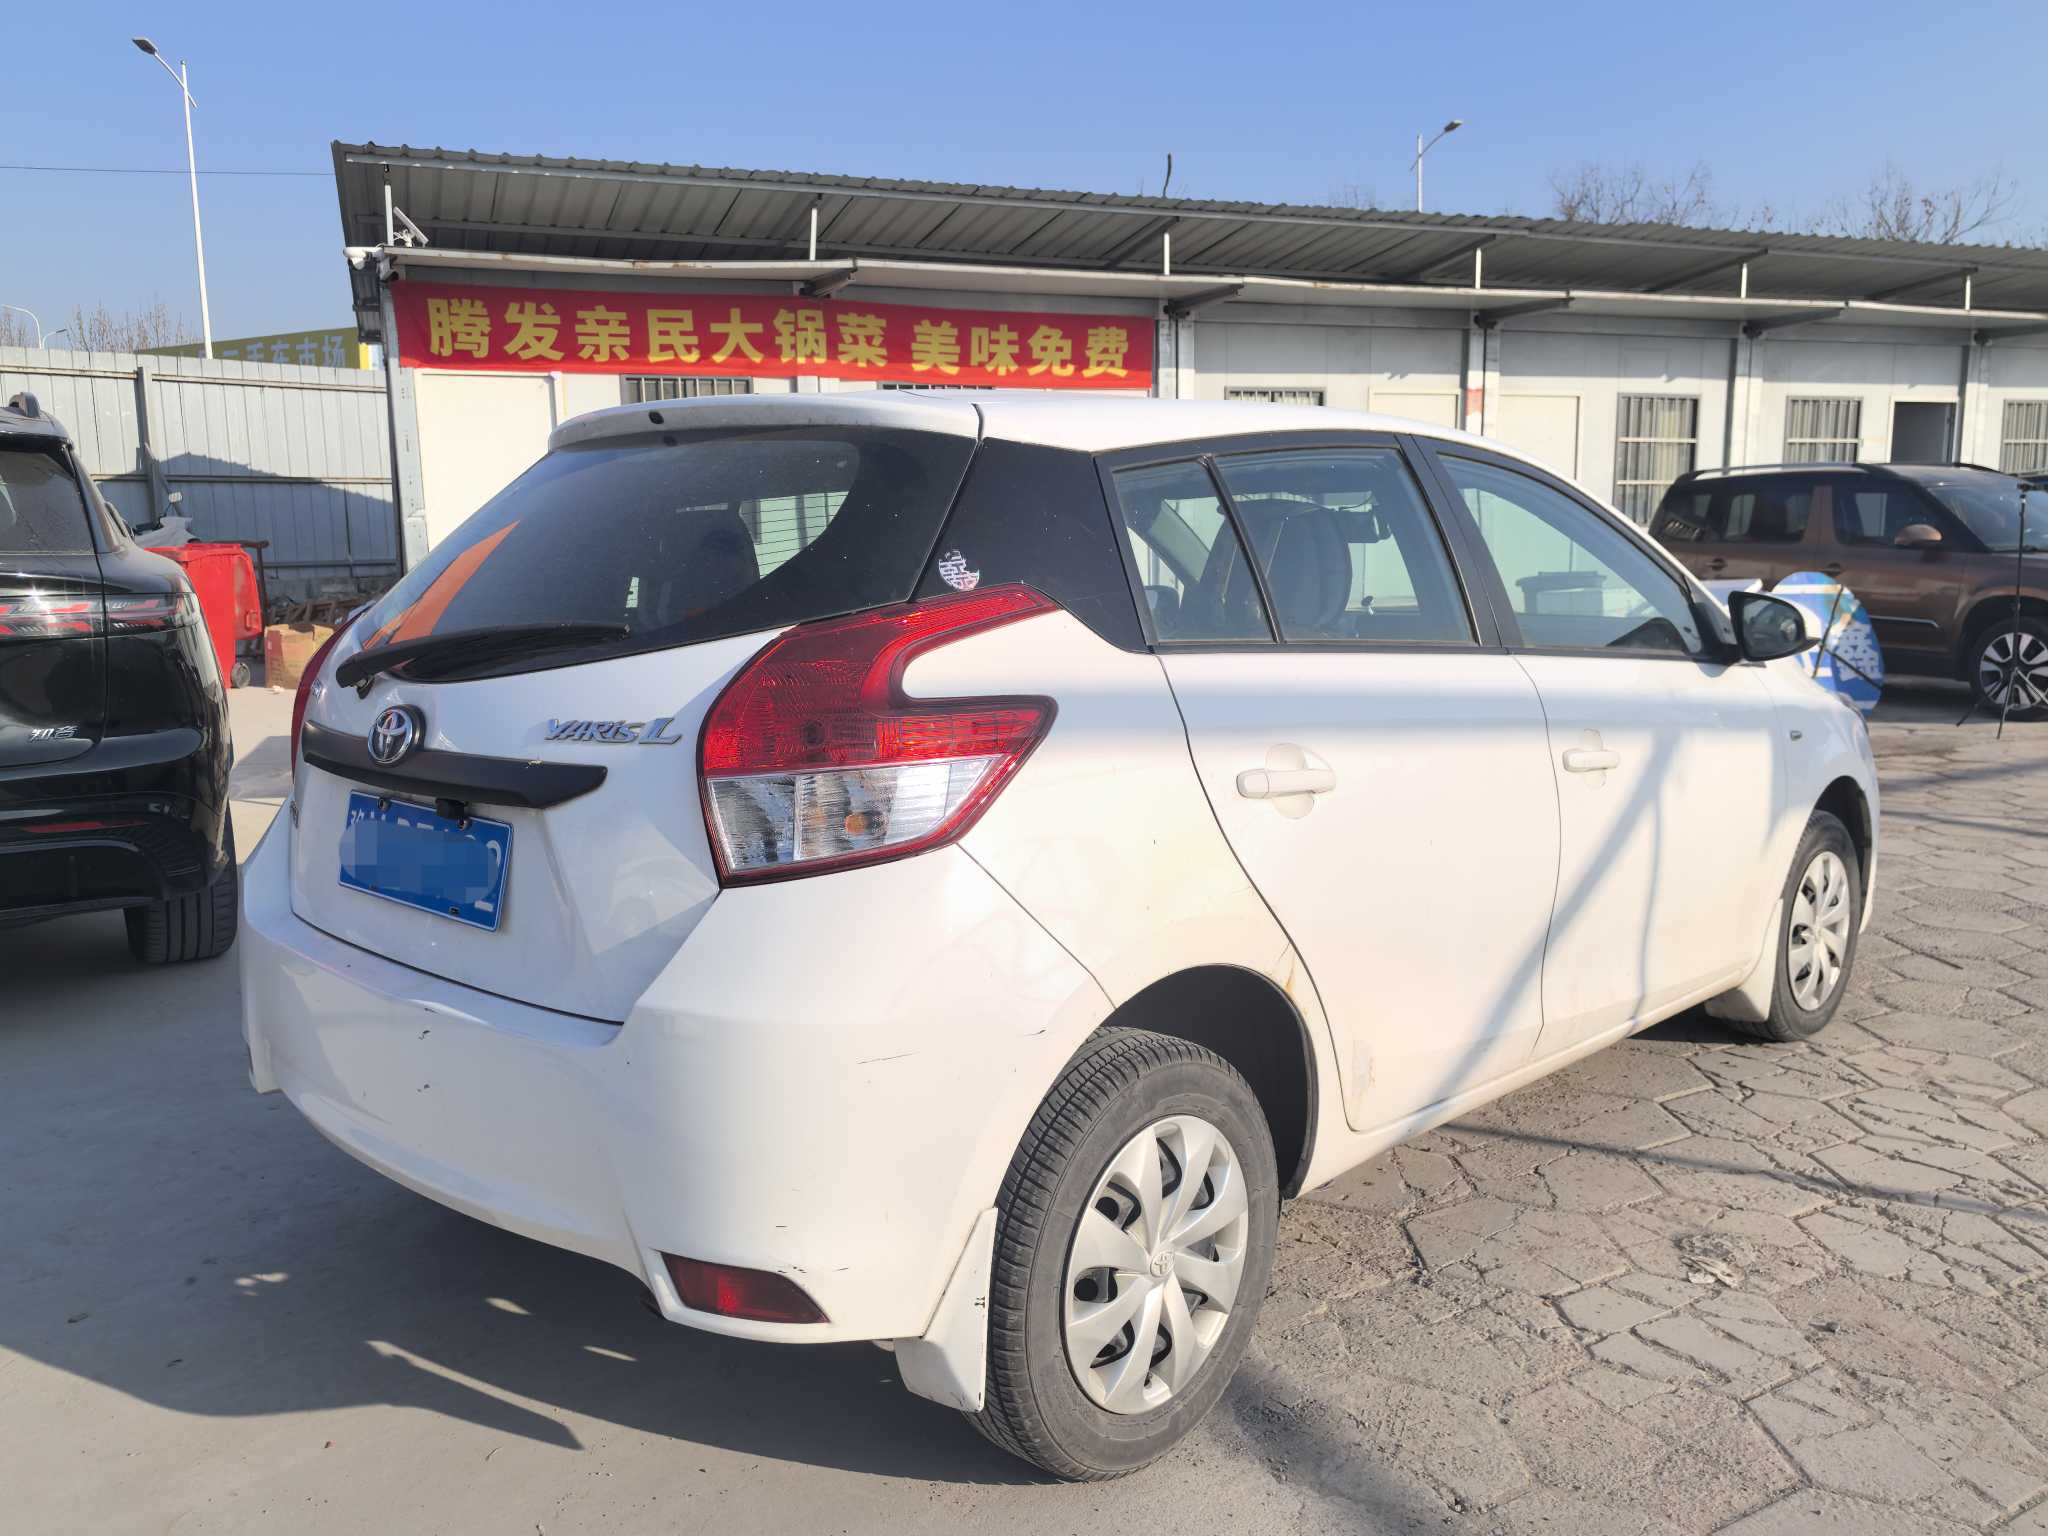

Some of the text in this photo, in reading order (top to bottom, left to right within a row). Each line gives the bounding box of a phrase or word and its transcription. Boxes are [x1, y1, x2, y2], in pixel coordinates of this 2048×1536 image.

[427, 298, 1129, 377] 腾发亲民大锅菜 美味免费
[544, 718, 683, 745] YARIS L
